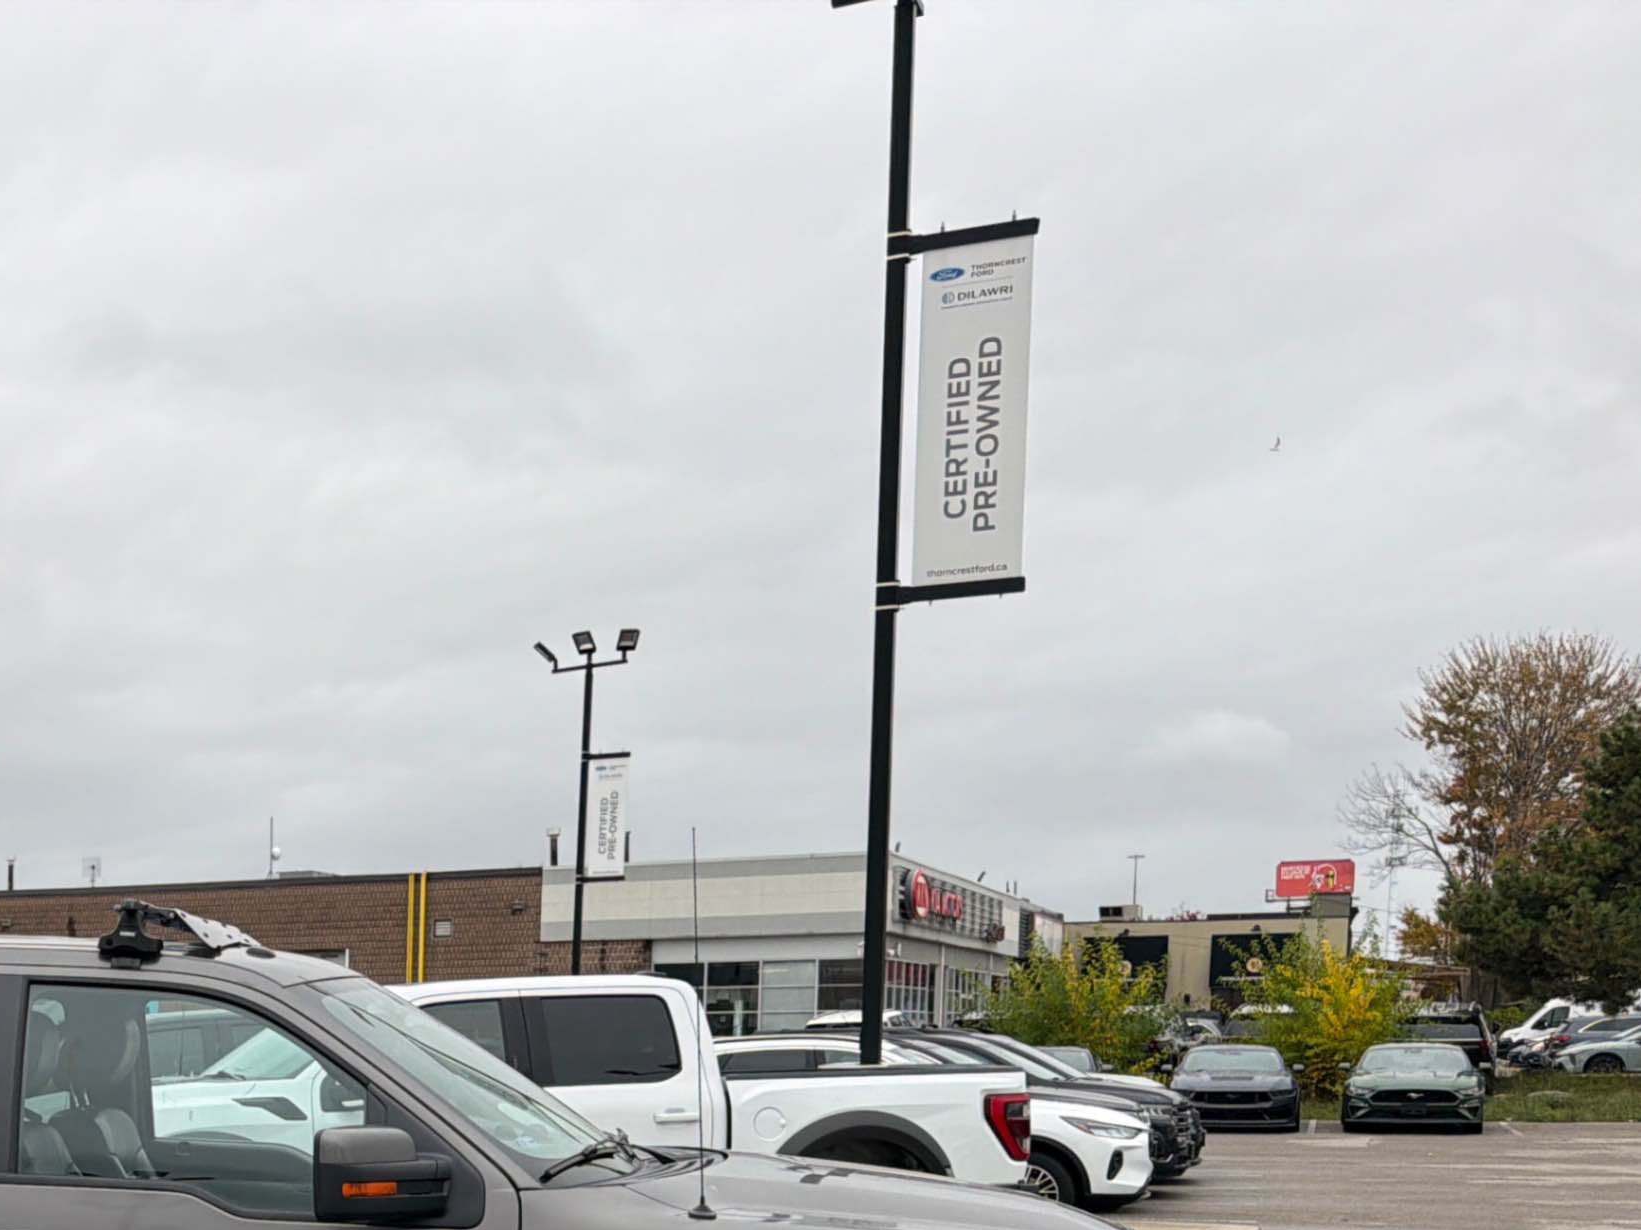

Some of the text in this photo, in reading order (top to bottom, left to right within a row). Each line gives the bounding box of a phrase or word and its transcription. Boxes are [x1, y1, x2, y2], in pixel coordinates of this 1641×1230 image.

[970, 256, 1027, 271] THORNCREST
[970, 269, 995, 278] FORD
[957, 285, 1014, 302] DILAWRI
[943, 357, 972, 520] CERTIFIED
[972, 336, 1003, 533] PRE-OWNED
[597, 797, 609, 855] CERTIFIED
